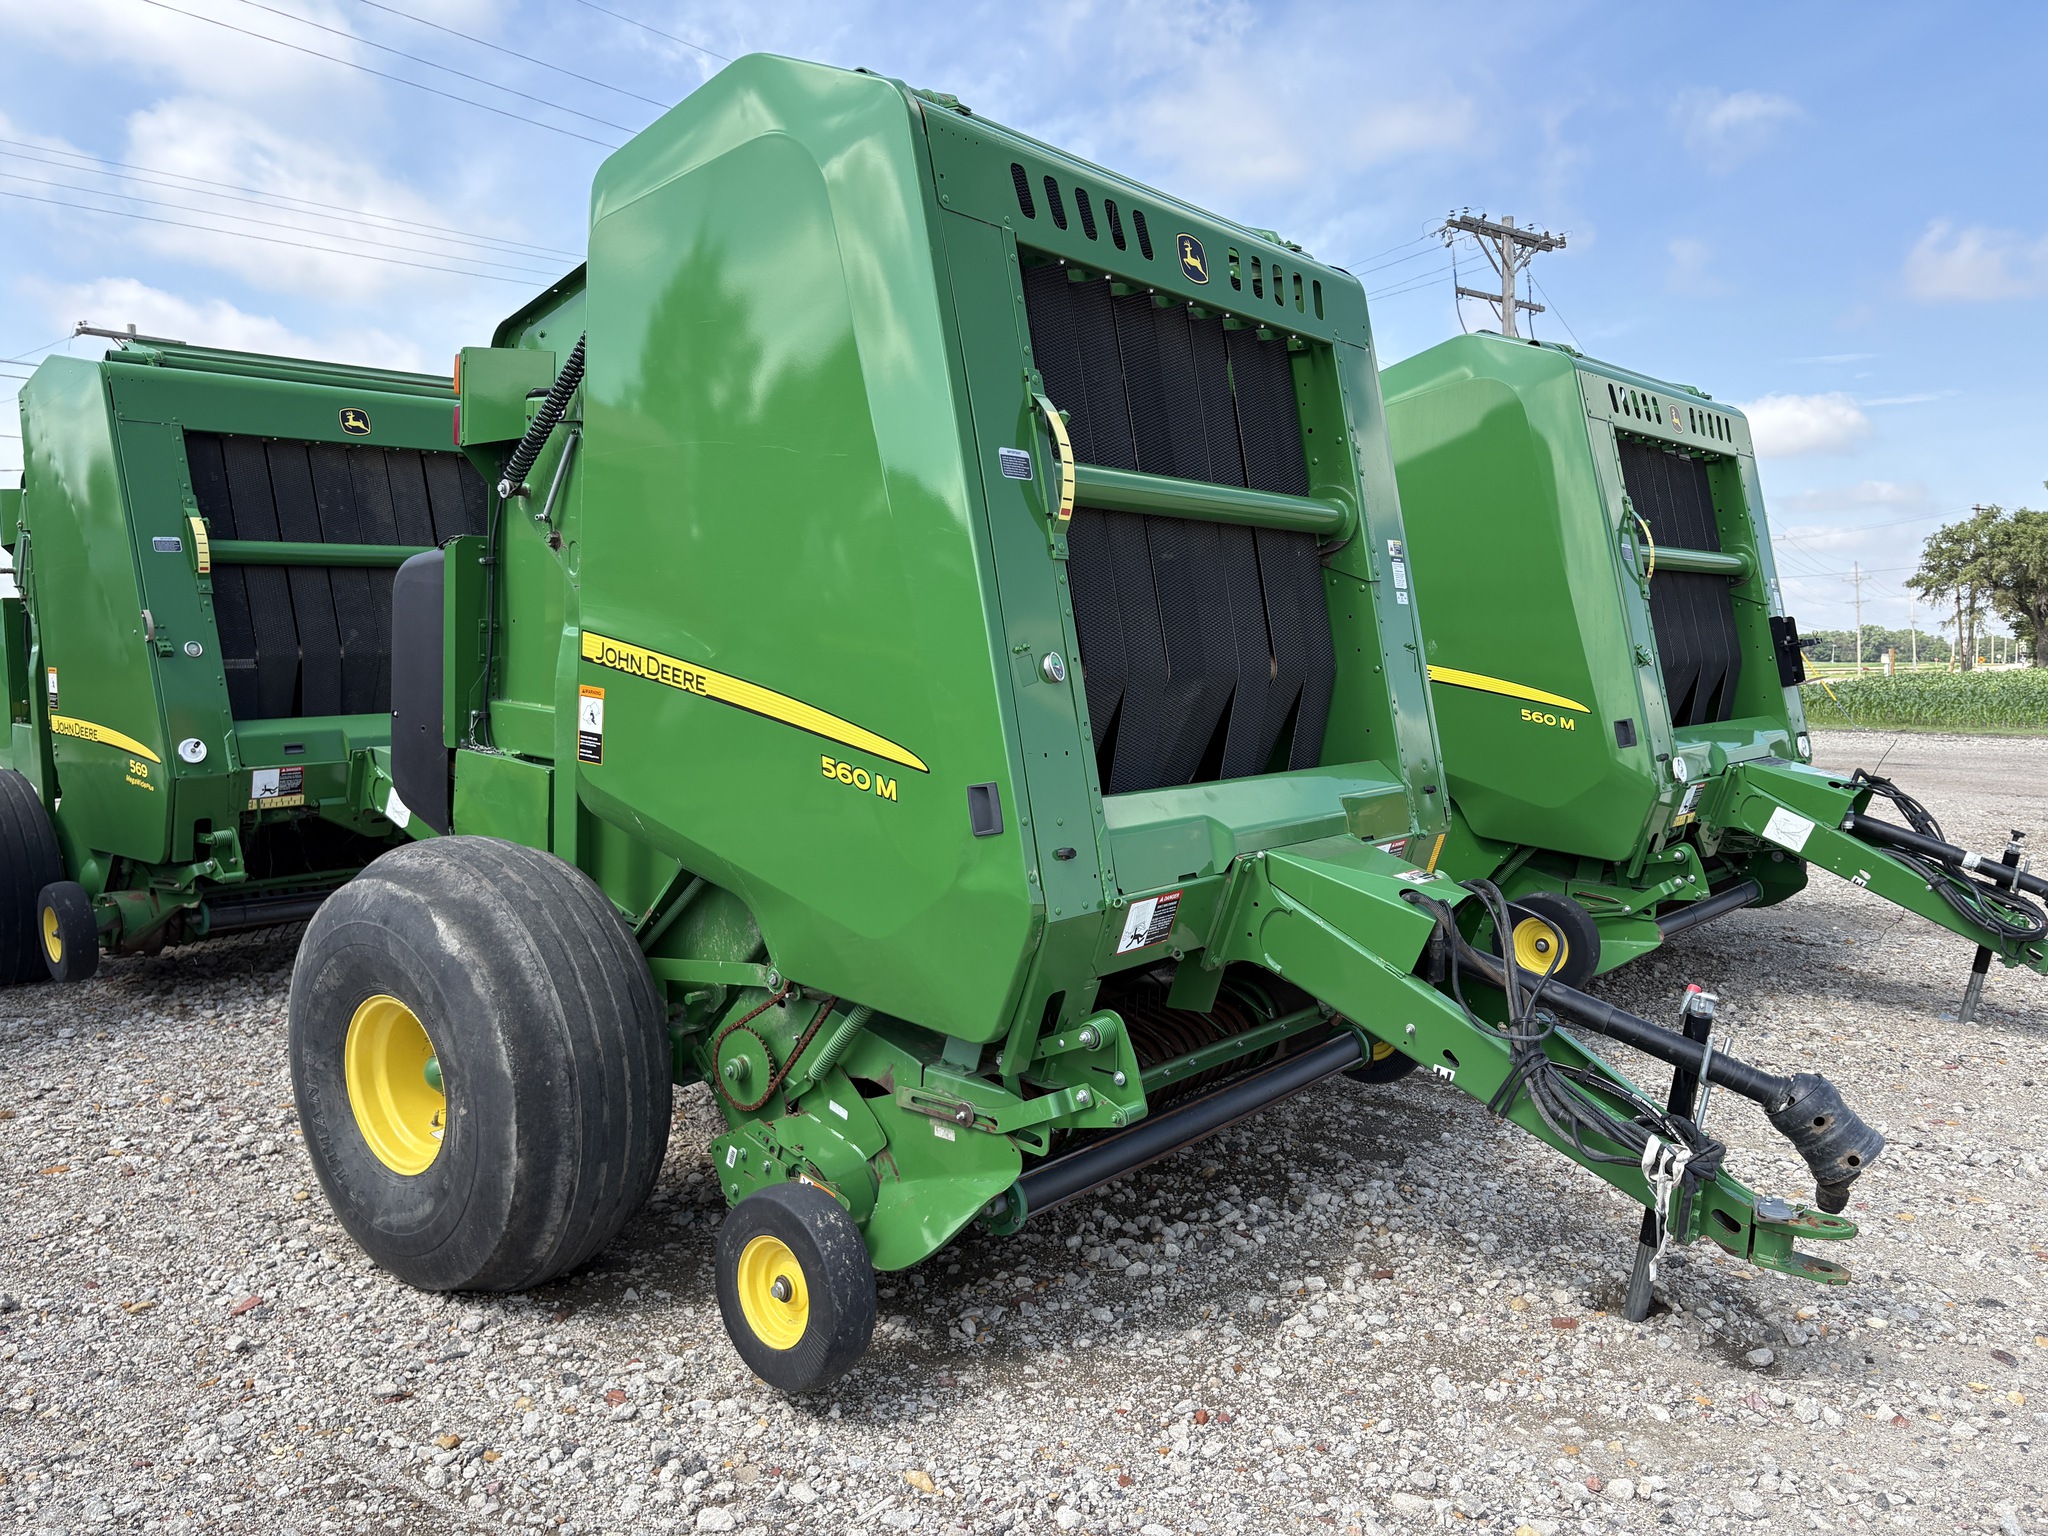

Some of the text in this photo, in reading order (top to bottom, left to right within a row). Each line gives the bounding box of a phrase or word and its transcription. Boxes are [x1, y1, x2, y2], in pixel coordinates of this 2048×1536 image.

[595, 641, 707, 693] JOHN DEERE
[55, 719, 98, 740] JOHN DEERE
[1520, 708, 1575, 731] 560 M
[129, 758, 148, 778] 569
[821, 754, 897, 803] 560 M
